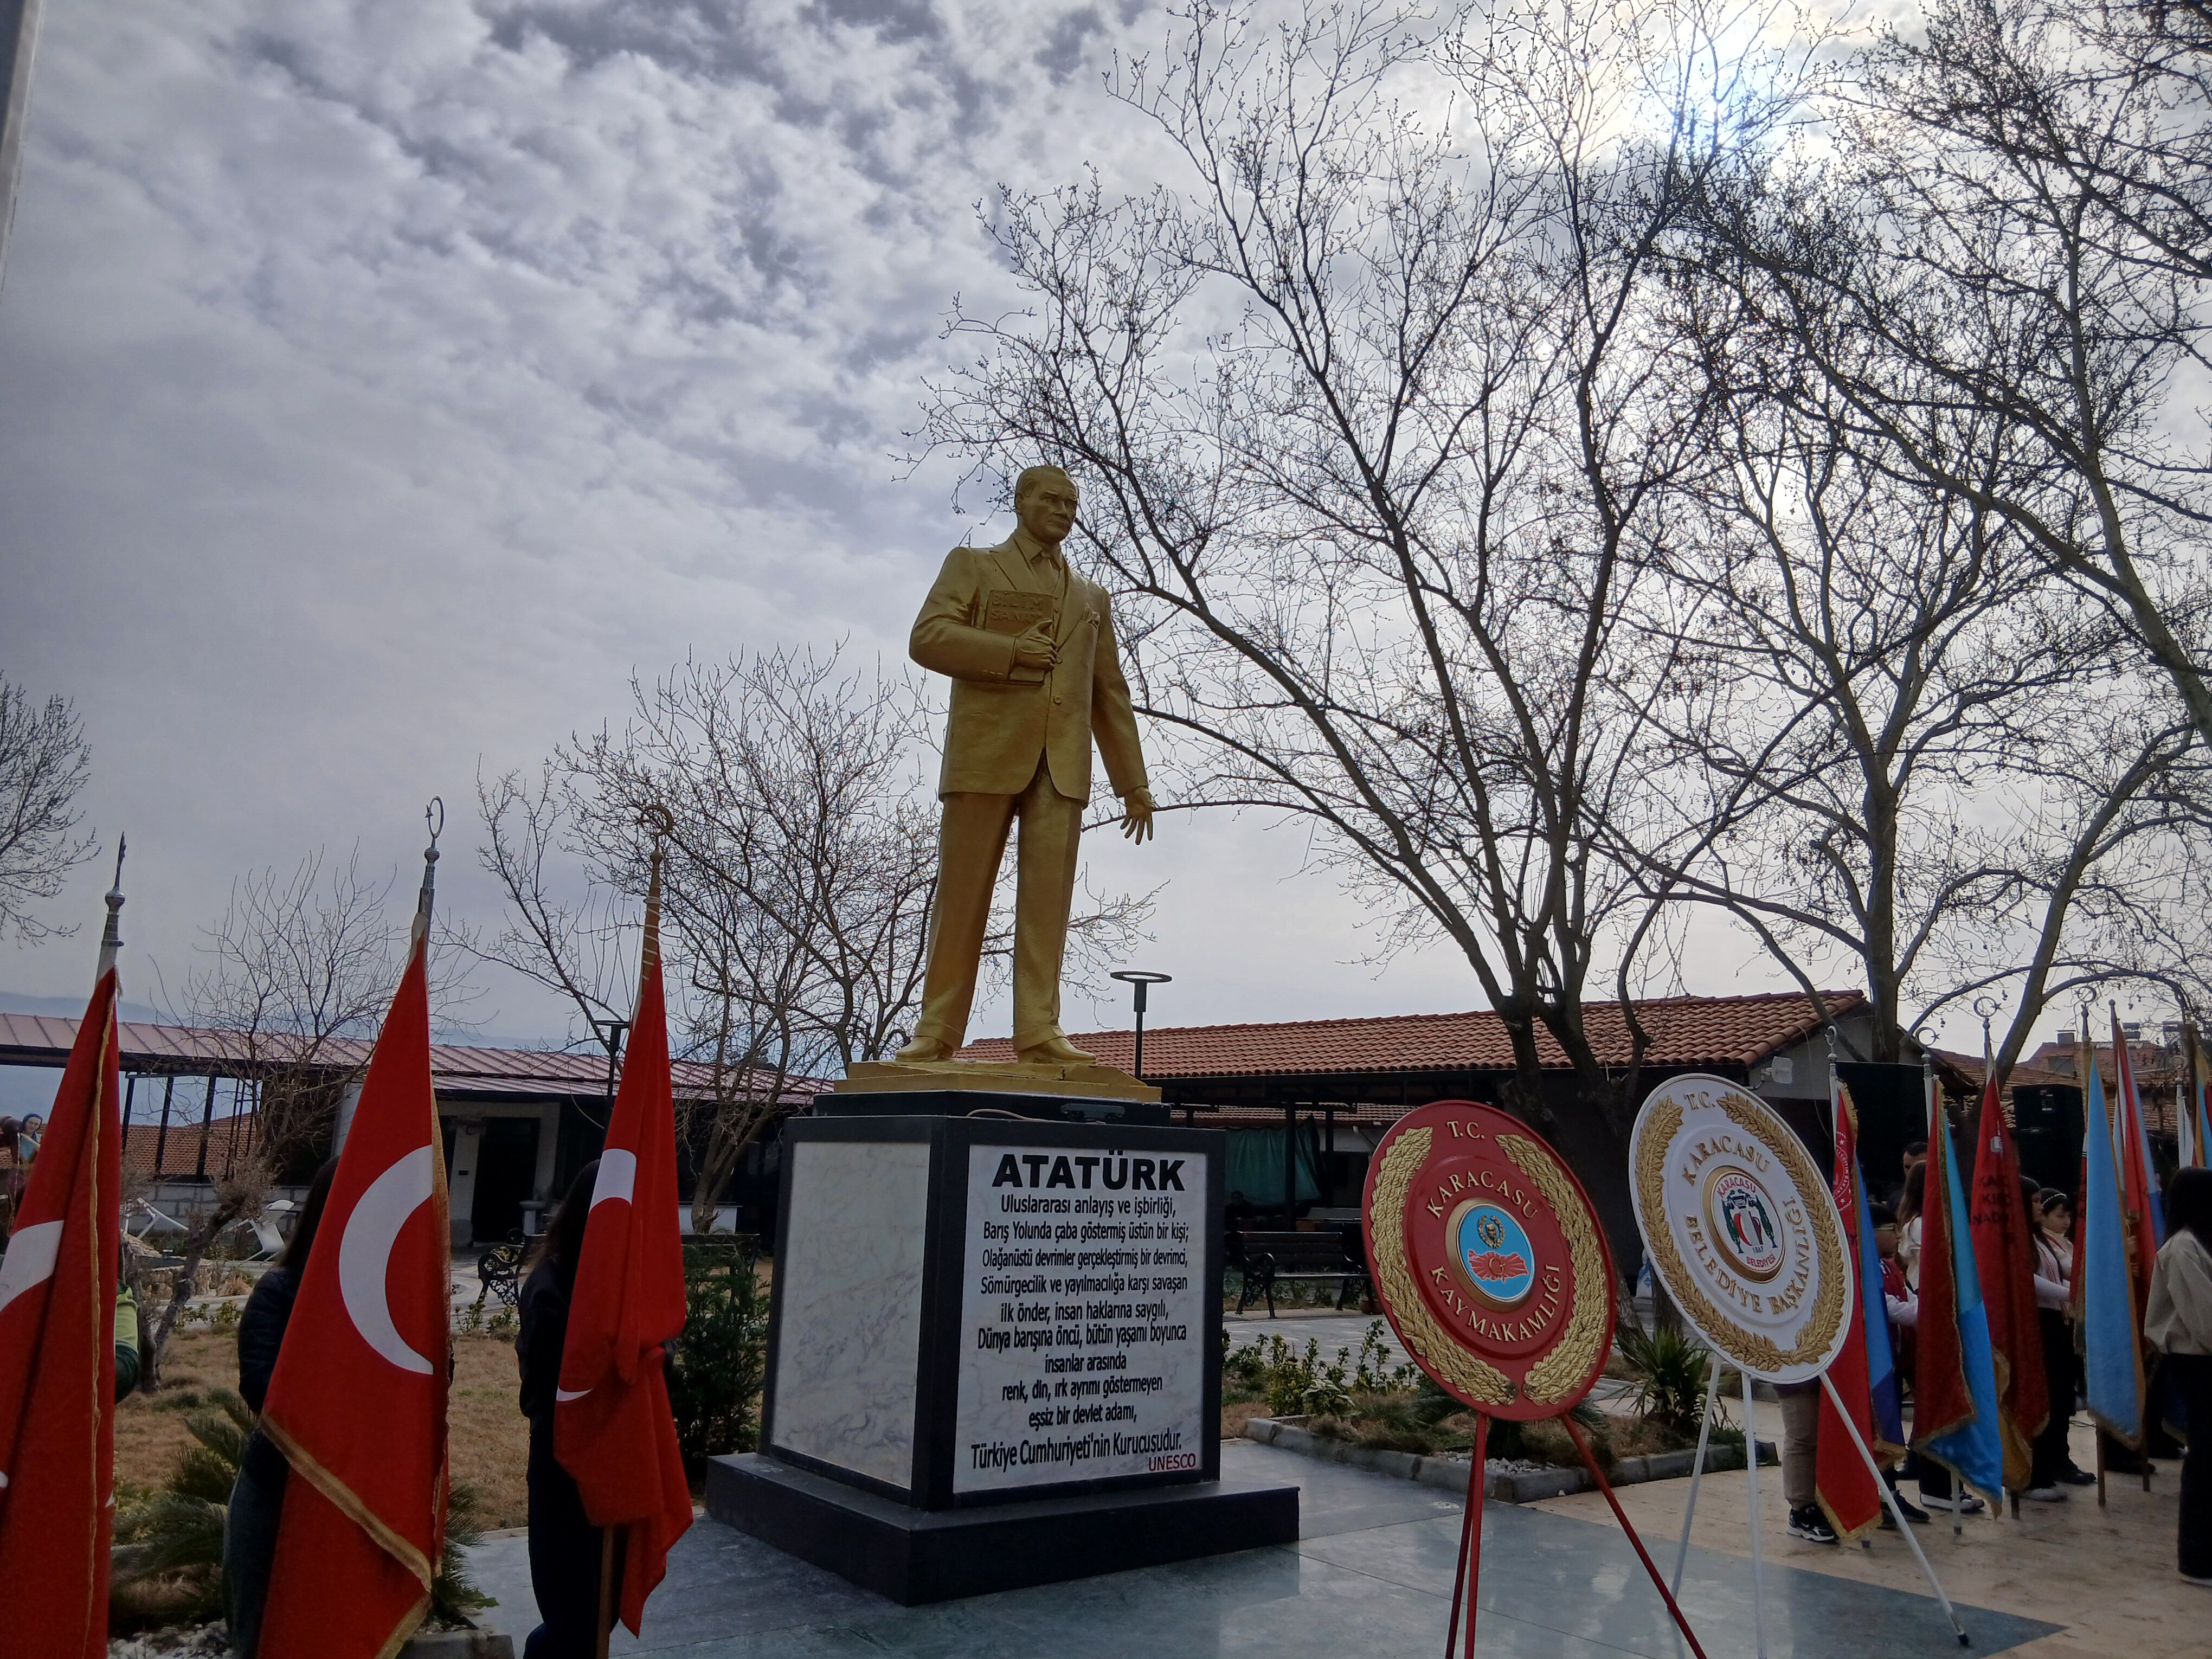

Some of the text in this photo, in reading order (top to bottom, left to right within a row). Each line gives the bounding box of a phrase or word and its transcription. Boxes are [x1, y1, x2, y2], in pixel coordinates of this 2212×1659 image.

[1683, 1091, 1715, 1110] T.C.
[1446, 1120, 1486, 1140] T.C.
[992, 1149, 1186, 1192] ATATÜRK
[1681, 1135, 1770, 1186] KARACASU
[1426, 1170, 1538, 1219] KARACASU
[1716, 1176, 1757, 1198] KARACASU
[1001, 1194, 1176, 1218] Uluslararası anlayış ve işbirliği,
[983, 1220, 1189, 1244] Barış Yolunda çaba göstermiş üstün bir kişi;
[982, 1247, 1188, 1271] Olağanüstü devrimler gerçekleştirmiş bir devrimci,
[1684, 1196, 1810, 1314] BELEDİYE BAŞKANLIĞI
[980, 1271, 1188, 1298] Sömürgecilik ve yayılmacılığa karşı savaşan
[1001, 1298, 1169, 1325] ilk önder, insan haklarına saygılı,
[1430, 1264, 1561, 1342] KAYMAKAMLIĞI
[978, 1321, 1187, 1354] Dünya barışına öncü, bütün yaşamı boyunca
[1045, 1351, 1127, 1374] insanlar arasında
[1002, 1375, 1163, 1404] renk, din, ırk ayrımı göstermeyen
[1028, 1401, 1137, 1432] eşsiz bir devlet adamı,
[970, 1427, 1182, 1473] Türkiye Cumhuriyeti'nin Kurucusudur.
[1148, 1453, 1196, 1471] UNESCO
